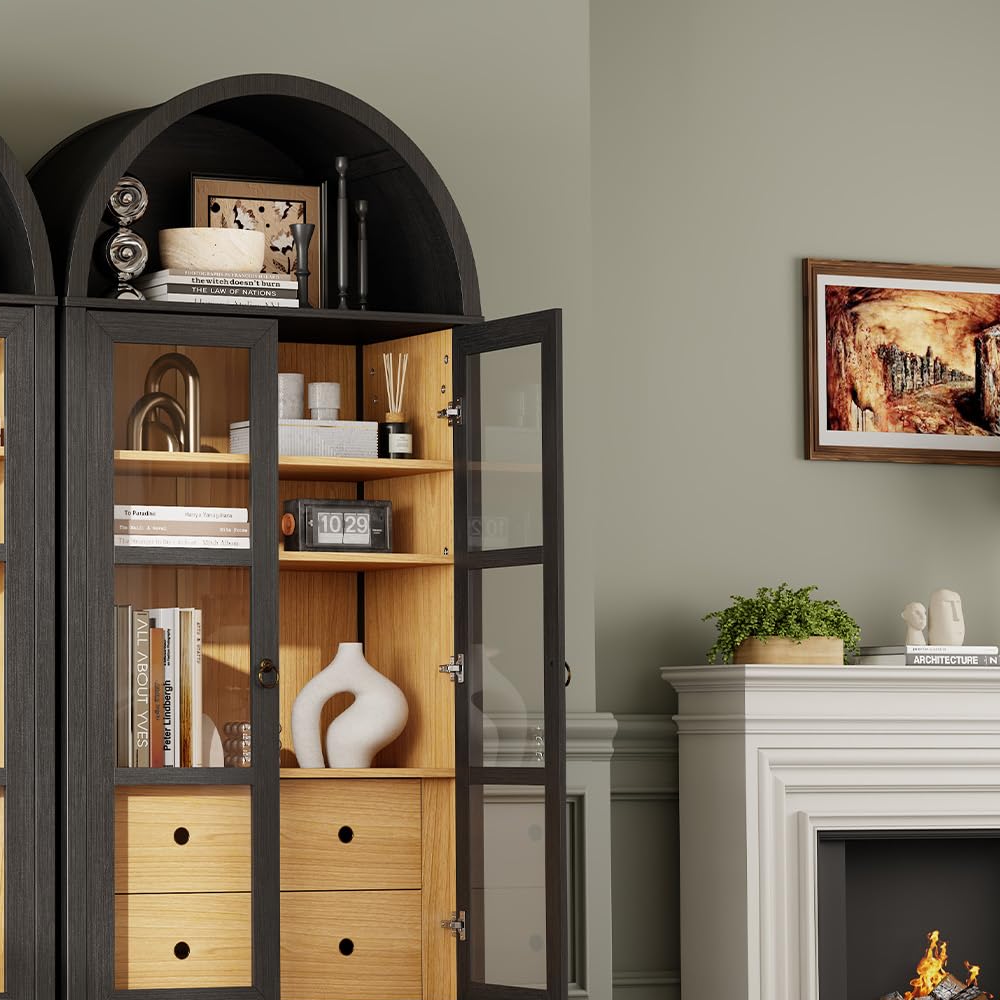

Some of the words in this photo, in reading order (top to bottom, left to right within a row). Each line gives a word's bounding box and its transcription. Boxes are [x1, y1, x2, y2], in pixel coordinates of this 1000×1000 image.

[242, 289, 277, 297] NATIONS
[261, 280, 281, 288] burn
[320, 514, 342, 533] 10
[344, 514, 369, 534] 29
[136, 618, 149, 646] ALL
[913, 656, 979, 665] ARCHITECTURE
[136, 651, 149, 705] ABOUT
[163, 679, 173, 725] Lindbergh
[136, 711, 149, 748] YVES
[163, 725, 171, 751] Peter
